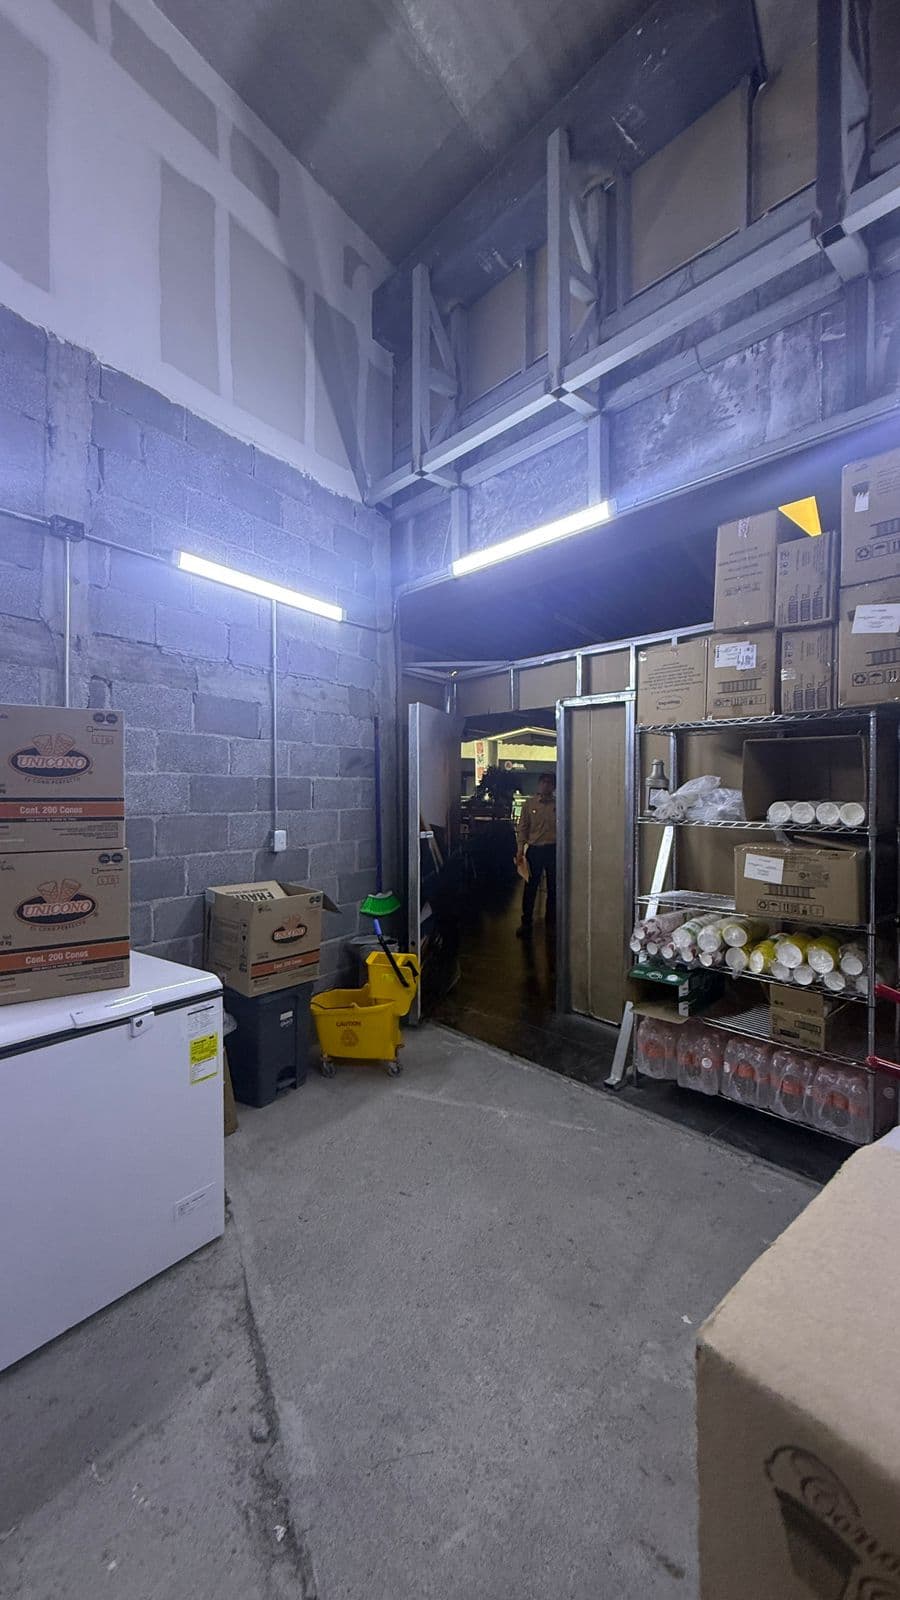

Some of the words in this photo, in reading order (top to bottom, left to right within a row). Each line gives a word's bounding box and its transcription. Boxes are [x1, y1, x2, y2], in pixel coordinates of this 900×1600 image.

[18, 756, 86, 768] UNICONO
[42, 806, 57, 814] 200
[60, 806, 83, 814] Conos
[24, 901, 91, 917] UNICONO
[48, 953, 63, 962] 200
[65, 950, 89, 960] Conos
